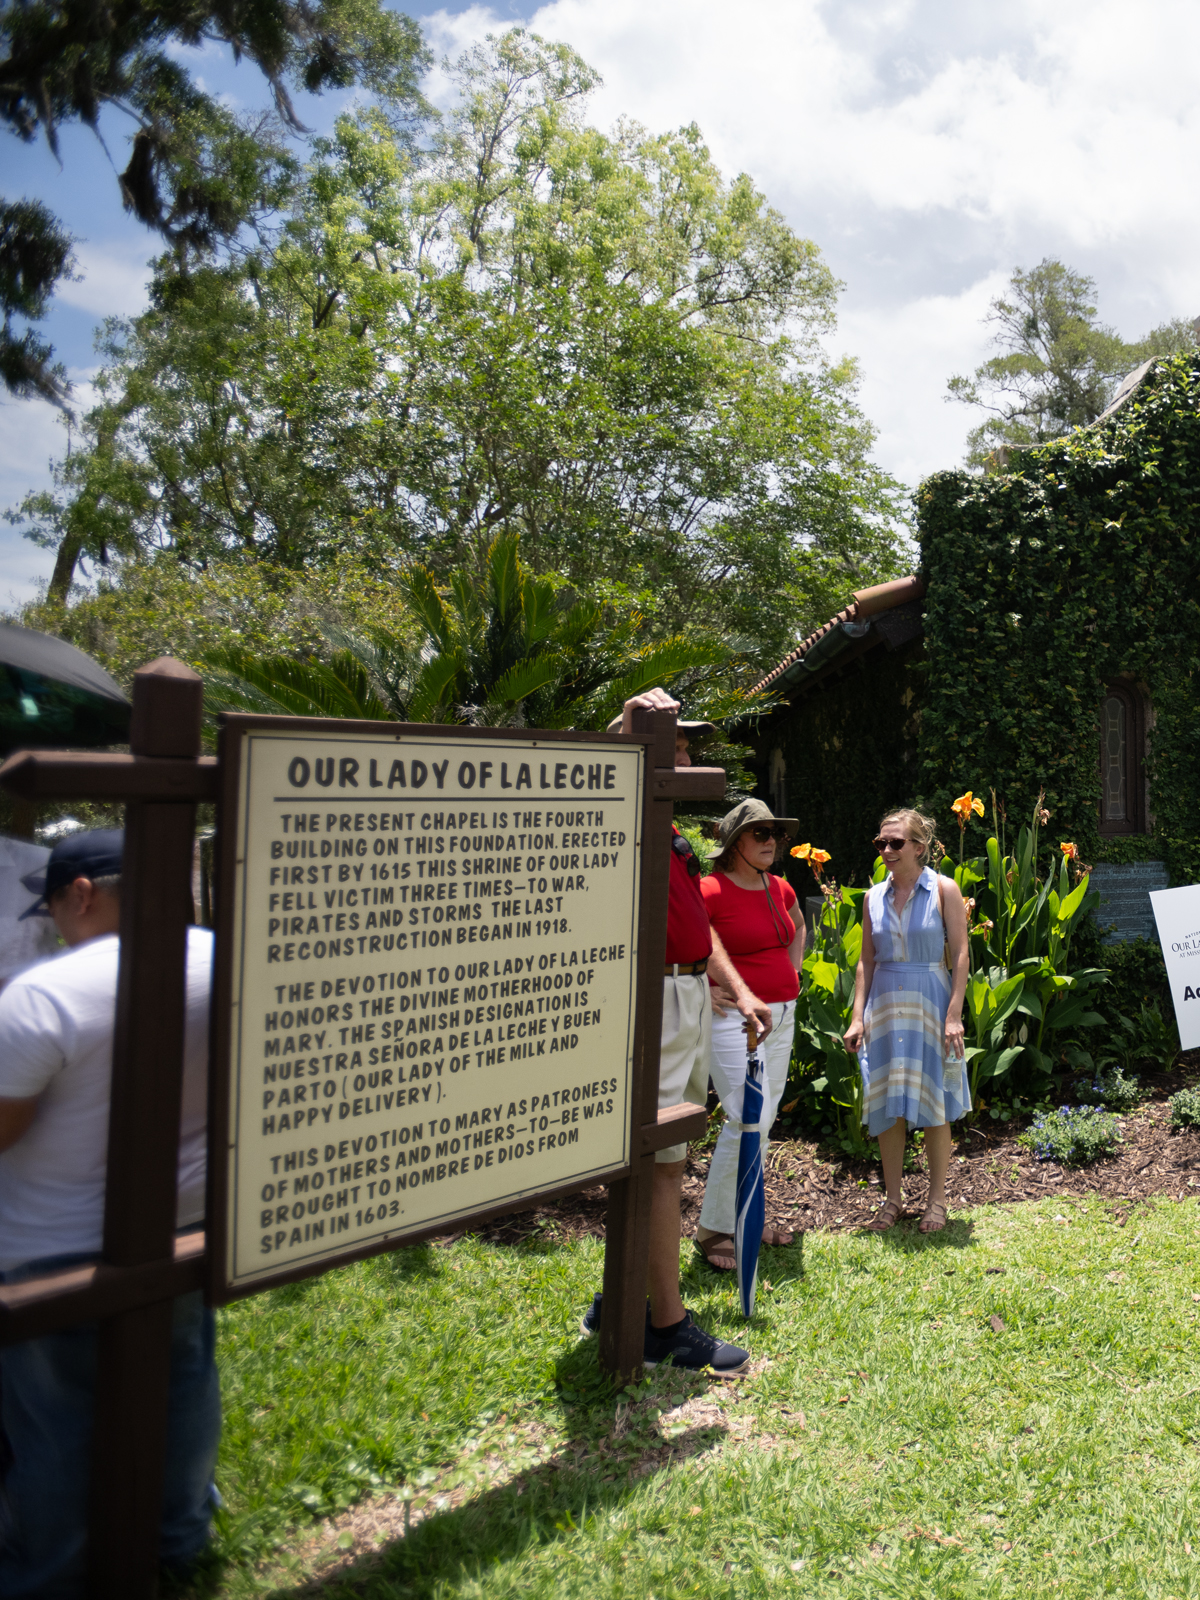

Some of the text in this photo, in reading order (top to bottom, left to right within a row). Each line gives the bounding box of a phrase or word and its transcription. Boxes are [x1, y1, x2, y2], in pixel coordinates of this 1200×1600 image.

[288, 756, 616, 790] OUR LADY OF LA LECHE
[271, 831, 626, 860] BUILDING ON THIS FOUNDATION. ERECTED
[280, 810, 603, 833] THE PRESENT CHAPEL IS THE FOURTH
[269, 892, 317, 912] FELL
[324, 886, 394, 908] VICTIM
[400, 882, 458, 903] THREE
[552, 875, 589, 892] WAR,
[270, 852, 618, 886] FIRST BY 1615 THIS SHRINE OF OUR LADY
[268, 896, 563, 937] PIRATES AND STORMS THE LAST
[268, 918, 572, 963] RECONSTRUCTION BEGAN IN 1918.
[265, 969, 594, 1032] HONORS THE DIVINE MOTHERHOOD OF
[275, 944, 625, 1004] THE DEVOTION TO OUR LADY OF LA LECHE
[264, 991, 588, 1058] MARY. THE SPANISH DESIGNATION IS
[264, 1008, 600, 1084] NUESTRA SEÑORA DE LA LECHE Y BUEN
[263, 1080, 336, 1110] PARTO
[398, 1058, 444, 1084] LADY
[450, 1054, 470, 1073] OF
[475, 1047, 506, 1068] THE
[510, 1039, 546, 1061] MILK
[550, 1034, 578, 1054] AND
[262, 1104, 333, 1136] HAPPY
[270, 1078, 617, 1174] THIS DEVOTION TO MARY AS PATRONESS
[261, 1180, 287, 1202] OF
[294, 1155, 390, 1195] MOTHERS
[395, 1146, 431, 1170] AND
[583, 1098, 613, 1120] WAS
[260, 1128, 578, 1228] BROUGHT TO NOMBRE DE DIOS FROM
[260, 1200, 404, 1254] SPAIN IN 1603.
